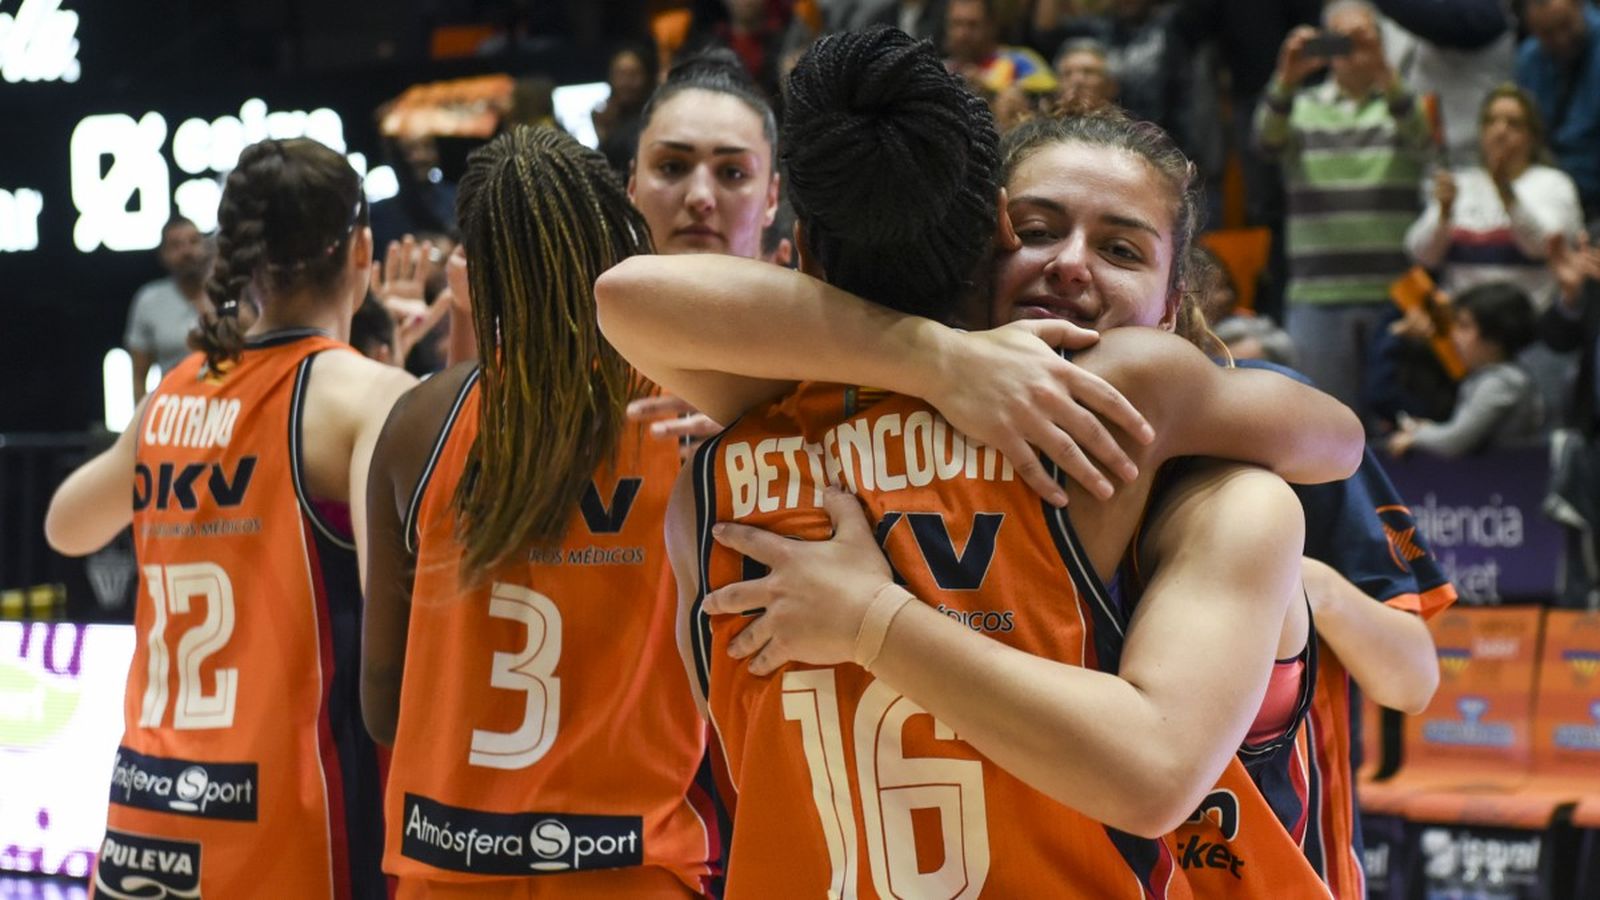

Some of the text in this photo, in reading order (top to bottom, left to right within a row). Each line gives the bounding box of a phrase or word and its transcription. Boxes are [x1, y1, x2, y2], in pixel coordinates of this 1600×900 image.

[144, 393, 241, 449] COTANO
[132, 455, 257, 512] DKV
[1413, 491, 1523, 547] alencia
[567, 544, 645, 566] MÉDICOS
[139, 561, 238, 730] 12
[468, 581, 562, 770] 3
[782, 669, 990, 900] 16
[101, 838, 193, 875] PULEVA
[406, 804, 636, 868] Atmósfera Sport
